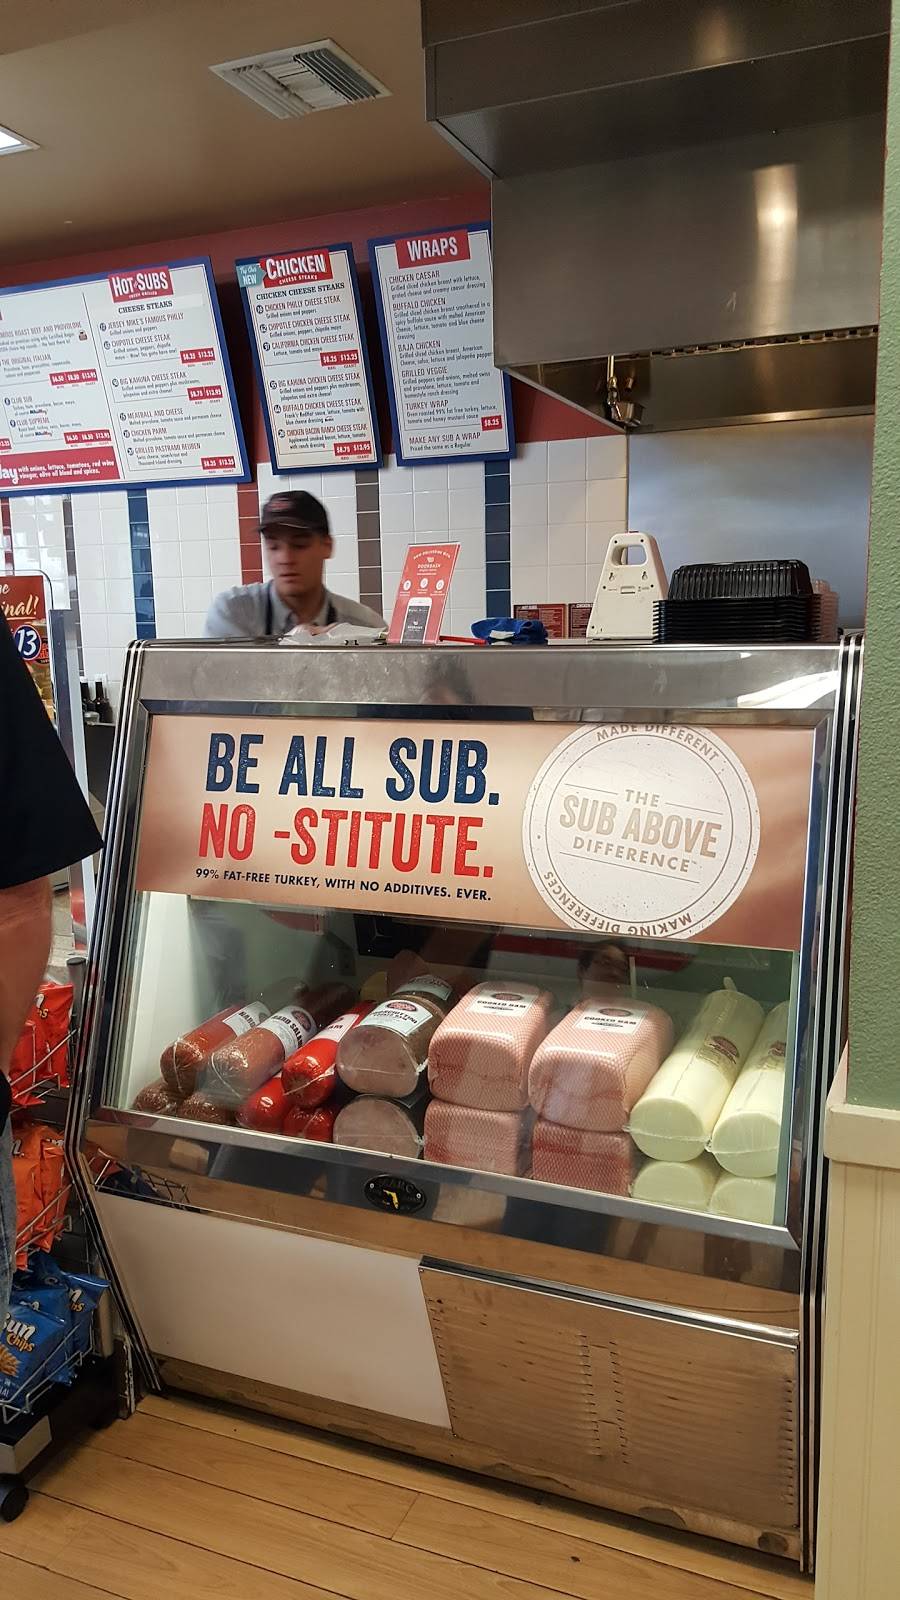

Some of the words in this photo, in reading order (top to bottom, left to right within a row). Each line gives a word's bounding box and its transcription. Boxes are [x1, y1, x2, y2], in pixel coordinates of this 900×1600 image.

[407, 237, 458, 262] WRAPS
[266, 254, 326, 280] CHICKEN
[112, 276, 134, 297] HOT
[138, 271, 169, 291] SUBS
[243, 274, 257, 285] NEW
[389, 273, 414, 284] CHICKEN
[415, 270, 440, 280] CAESAR
[256, 290, 287, 300] CHICKEN
[289, 286, 316, 296] CHEESE
[318, 282, 345, 291] STEAKS
[118, 305, 145, 314] CHEESE
[147, 301, 173, 310] STEAKS
[264, 303, 286, 312] CHICKEN
[287, 301, 302, 309] PHILLY
[304, 299, 322, 307] CHEESE
[324, 296, 341, 304] STEAK
[392, 301, 418, 311] BUFFALO
[421, 297, 446, 307] CHICKEN
[108, 321, 125, 329] JERSEY
[145, 315, 166, 324] FAMOUS
[268, 322, 291, 331] CHIPOTLE
[292, 319, 313, 328] CHICKEN
[314, 317, 333, 325] CHEESE
[334, 314, 350, 322] STEAK
[112, 339, 133, 347] CHIPOTLE
[135, 336, 154, 344] CHEESE
[155, 334, 170, 342] STEAK
[272, 340, 299, 349] CALIFORNIA
[300, 338, 319, 346] CHICKEN
[398, 344, 414, 352] BAJA
[416, 340, 441, 350] CHICKEN
[151, 373, 169, 381] CHEESE
[170, 371, 187, 379] STEAK
[287, 378, 306, 386] KAHUNA
[308, 376, 326, 384] CHICKEN
[328, 374, 344, 382] CHEESE
[345, 372, 360, 380] STEAK
[402, 369, 425, 377] GRILLED
[427, 367, 447, 375] VEGGIE
[165, 408, 183, 416] CHEESE
[283, 404, 304, 412] BUFFALO
[305, 402, 325, 410] CHICKEN
[327, 400, 344, 408] CHEESE
[406, 402, 428, 410] TURKEY
[430, 400, 448, 408] WRAP
[409, 436, 426, 444] MAKE
[135, 446, 154, 454] GRILLED
[18, 629, 37, 655] 13
[597, 725, 637, 741] MADE
[645, 725, 719, 760] DIFFERENT
[206, 733, 264, 793] BE
[278, 735, 364, 798] ALL
[386, 737, 499, 805] SUB.
[625, 789, 660, 807] THE
[560, 795, 617, 835] SUB
[621, 808, 722, 858] ABOVE
[199, 803, 256, 860] NO
[274, 808, 493, 878] -STITUTE.
[196, 869, 219, 879] 99%
[224, 870, 270, 883] FAT-FREE
[275, 874, 320, 888] TURKEY,
[325, 878, 355, 889] WITH
[360, 881, 379, 891] NO
[384, 882, 450, 897] ADDITIVES.
[457, 888, 491, 900] EVER.
[544, 872, 620, 933] DIFFERENCES
[628, 913, 691, 936] MAKING
[7, 1331, 35, 1352] Chips
